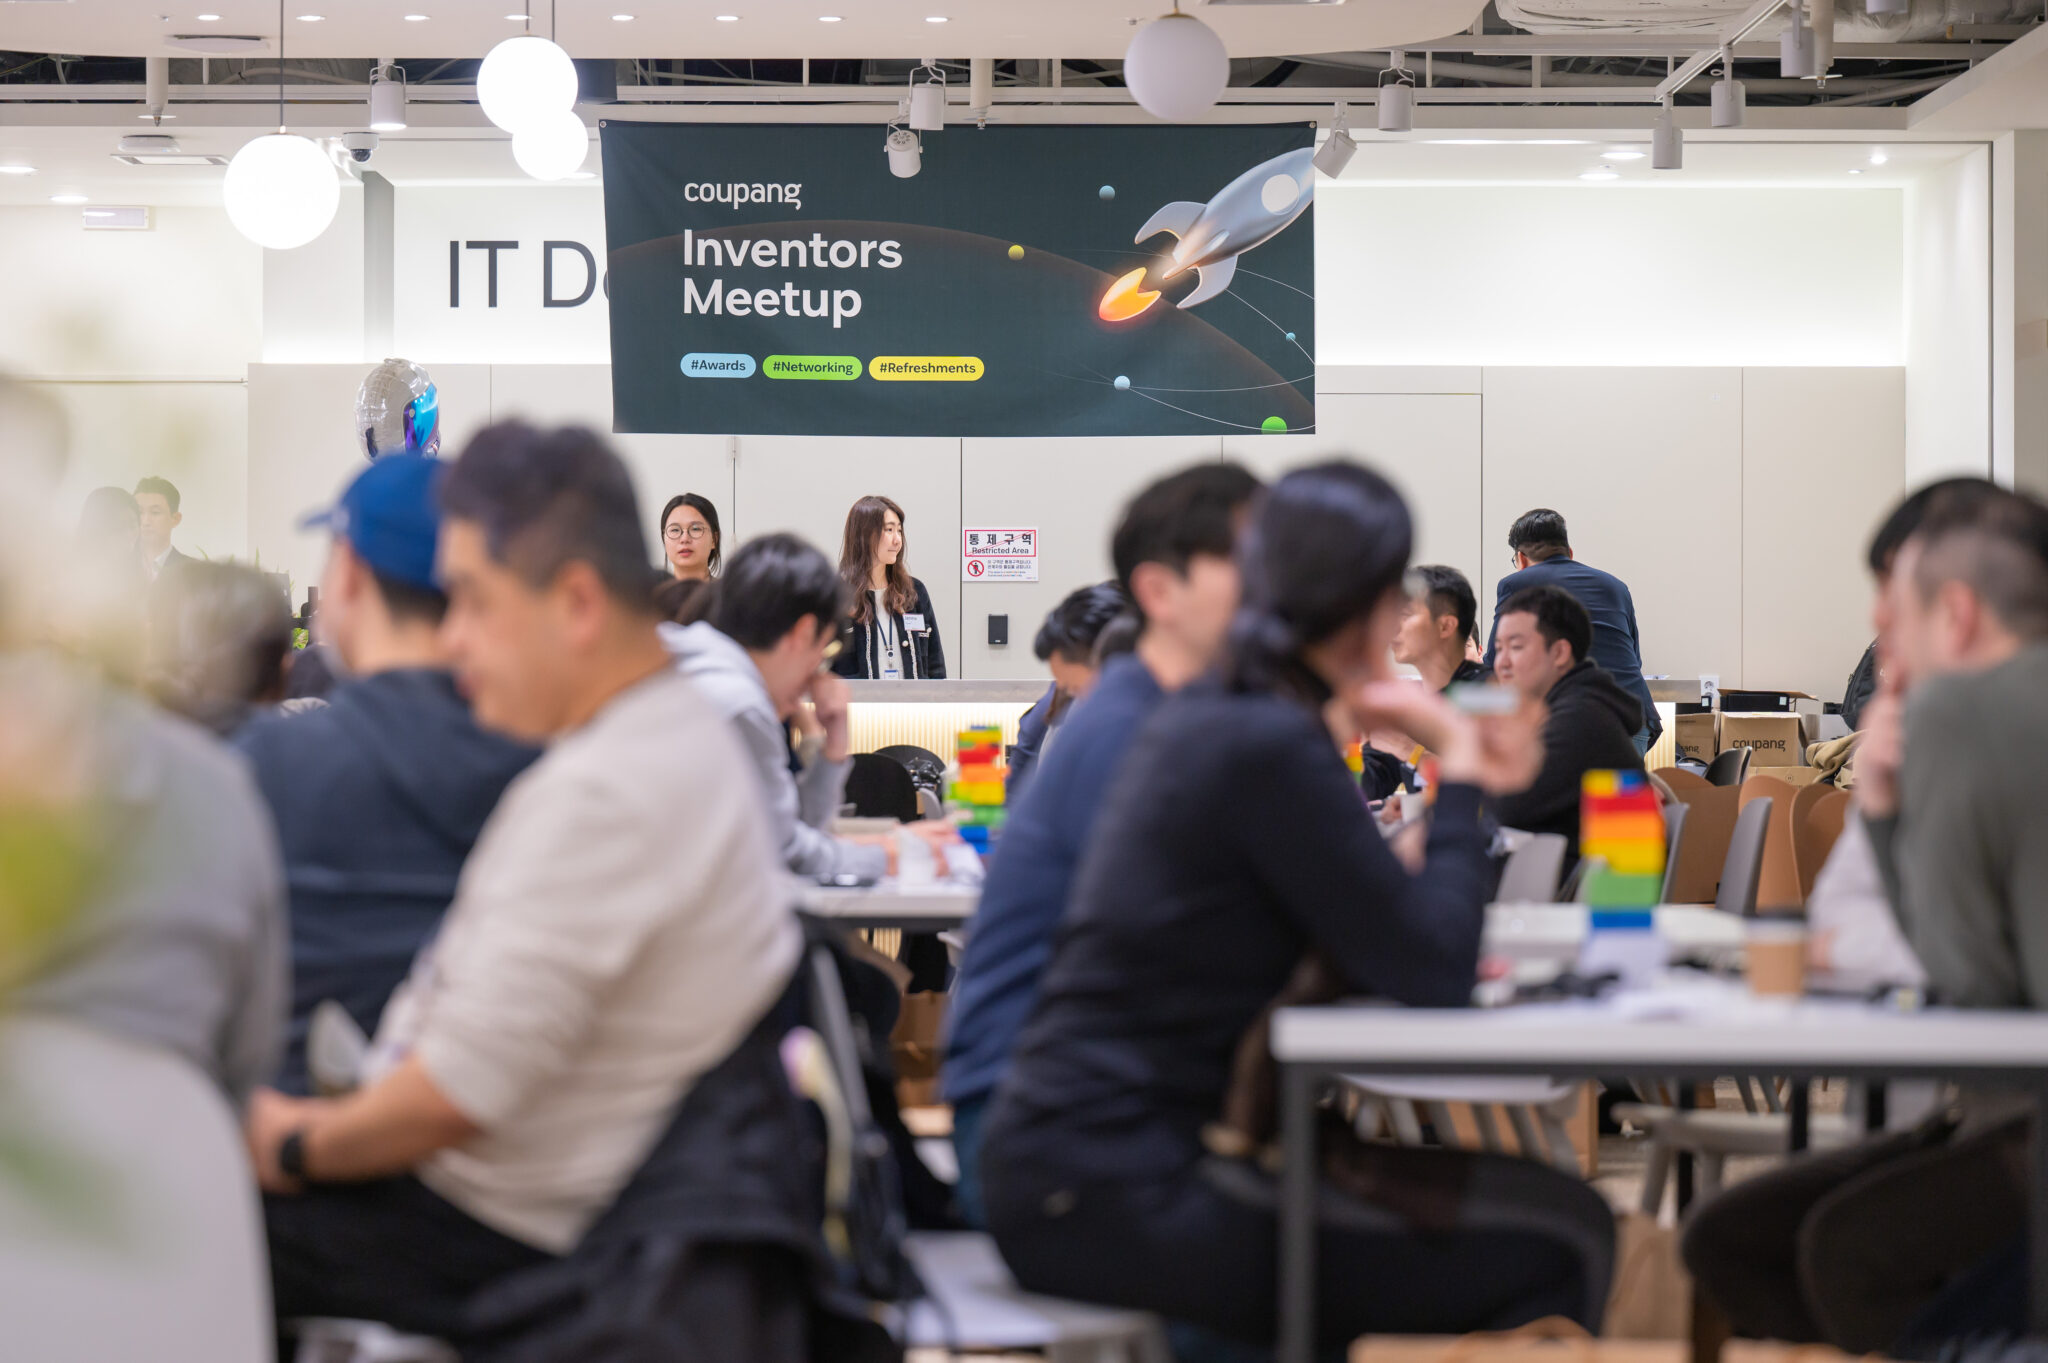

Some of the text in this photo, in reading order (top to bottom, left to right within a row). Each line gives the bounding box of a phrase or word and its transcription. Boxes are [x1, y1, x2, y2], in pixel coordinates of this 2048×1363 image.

[684, 182, 802, 211] coupang
[684, 229, 903, 269] Inventors
[449, 240, 608, 308] IT D
[684, 278, 862, 329] Meetup
[691, 359, 747, 372] #Awards
[772, 360, 854, 376] #Networking
[879, 361, 977, 374] #Refreshments
[1732, 739, 1786, 752] coupang
